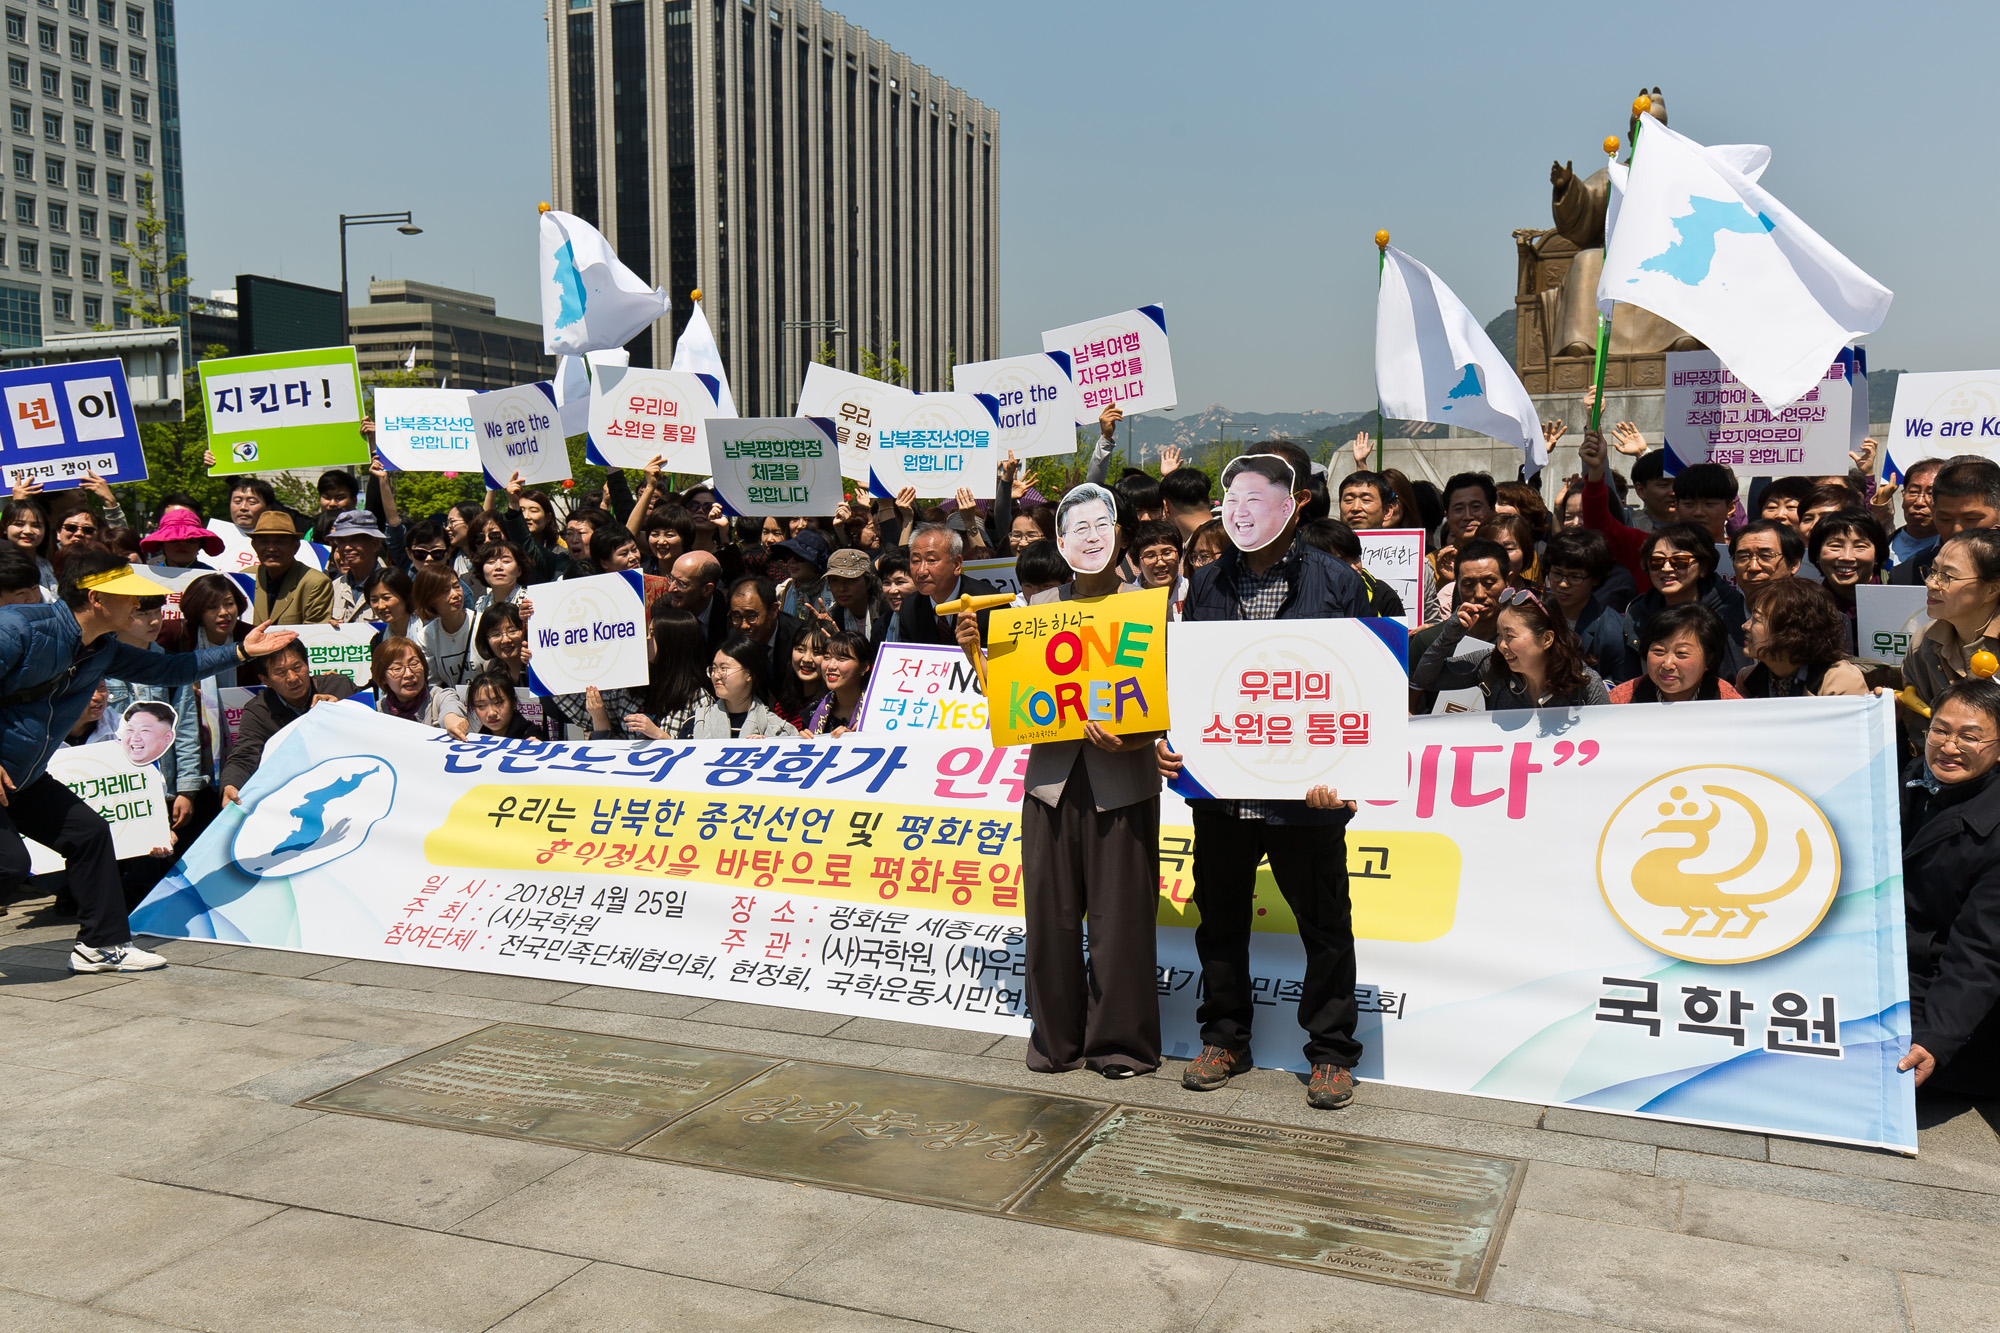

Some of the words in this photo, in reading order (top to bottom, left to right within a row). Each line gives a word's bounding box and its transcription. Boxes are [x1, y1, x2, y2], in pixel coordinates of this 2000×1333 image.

[1074, 332, 1140, 364] 남북여행
[1078, 357, 1142, 386] 자유화를
[629, 396, 678, 417] 우리의
[998, 390, 1023, 406] are
[1030, 384, 1057, 400] the
[1083, 380, 1144, 408] 원합니다
[1694, 390, 1746, 405] 제거하여
[18, 398, 56, 430] 년
[78, 391, 117, 418] 이
[1687, 410, 1740, 425] 조성하고
[484, 422, 503, 439] We
[506, 419, 526, 434] are
[528, 414, 550, 431] the
[606, 420, 656, 440] 소원은
[662, 424, 696, 444] 통일
[1708, 428, 1802, 444] 보호지역으로의
[1906, 418, 1933, 437] We
[1940, 421, 1974, 436] are
[410, 436, 469, 450] 원합니다
[506, 437, 539, 457] world
[724, 440, 822, 458] 남북평화협정
[879, 430, 990, 449] 남북종전선언을
[904, 454, 963, 472] 원합니다
[1706, 450, 1744, 464] 지정을
[1750, 448, 1804, 464] 원합니다
[10, 464, 54, 480] 벤자민
[752, 463, 800, 480] 체결을
[748, 486, 808, 502] 원합니다
[1362, 546, 1418, 566] 계평화
[538, 628, 559, 648] We
[564, 627, 588, 645] are
[593, 621, 636, 642] Korea
[1008, 618, 1048, 644] 우리는
[1052, 612, 1094, 632] 하나
[307, 644, 372, 664] 평화협
[1046, 622, 1153, 676] ONE
[1240, 670, 1330, 702] 우리의
[1009, 676, 1148, 730] KOREA
[1202, 714, 1294, 744] 소원은
[1306, 713, 1370, 745] 통일
[704, 744, 908, 793] 평화가
[488, 796, 576, 832] 우리는
[590, 798, 684, 837] 남북한
[696, 802, 834, 844] 종전선언
[846, 812, 883, 848] 및
[896, 815, 1022, 856] 평화협
[536, 838, 700, 877] 홍익정신을
[716, 848, 852, 888] 바탕으로
[870, 856, 1022, 908] 평화통일
[420, 876, 449, 894] 일
[457, 879, 486, 898] 시
[504, 883, 585, 910] 2018년
[591, 886, 628, 914] 4월
[634, 889, 686, 918] 25일
[730, 896, 756, 924] 장
[770, 900, 796, 923] 소
[830, 905, 910, 934] 광화문
[403, 896, 429, 918] 주
[438, 900, 468, 922] 최
[488, 905, 601, 936] (사)국학원
[720, 928, 747, 954] 주
[764, 932, 791, 960] 관
[822, 934, 936, 976] (사)국학원,
[384, 922, 478, 952] 참여단체
[499, 934, 717, 982] 전국민족단체협의회,
[730, 959, 812, 992] 현정회,
[1595, 976, 1840, 1057] 국학원
[1326, 1255, 1376, 1271] Mayor
[1379, 1265, 1398, 1275] of
[1403, 1269, 1449, 1283] Seoul
